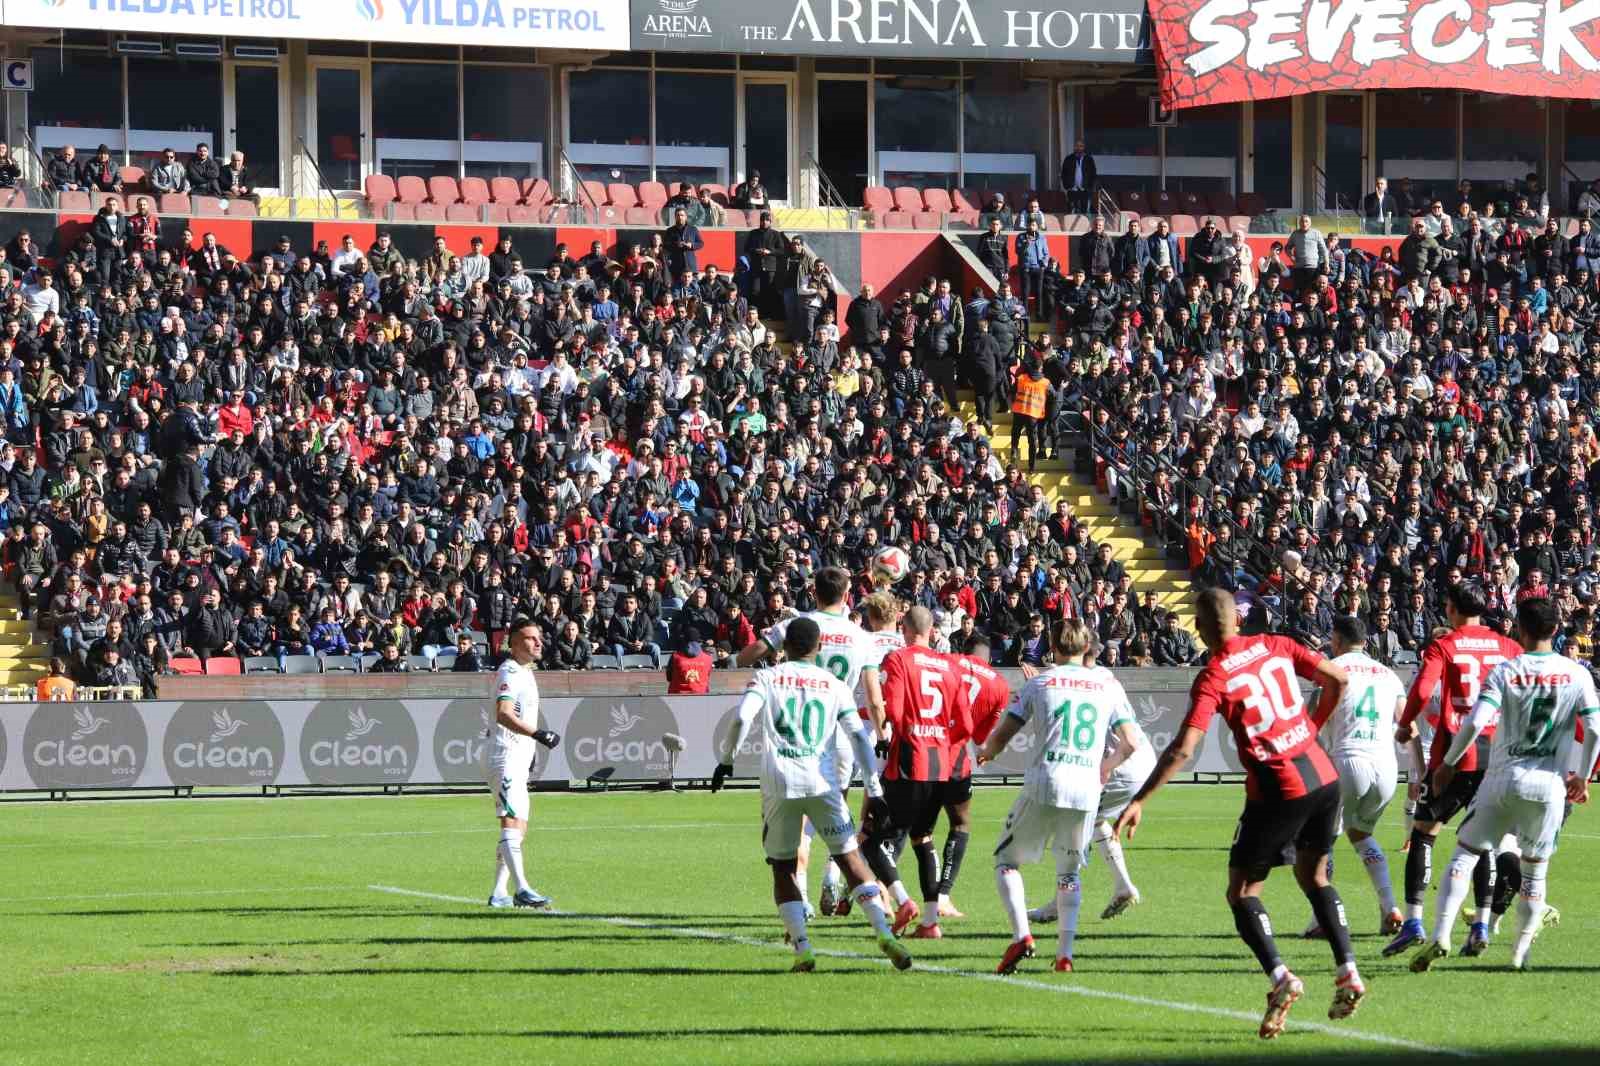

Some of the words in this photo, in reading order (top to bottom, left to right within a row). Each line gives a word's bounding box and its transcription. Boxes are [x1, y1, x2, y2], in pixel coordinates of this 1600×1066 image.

[512, 7, 606, 31] PETROL
[643, 15, 712, 33] ARENA
[740, 26, 777, 40] THE
[781, 0, 988, 46] ARENA
[8, 62, 26, 86] C
[919, 670, 943, 719] 5
[1226, 656, 1304, 738] 30
[1355, 686, 1379, 722] 4
[774, 697, 826, 748] 40
[1054, 700, 1098, 750] 18
[33, 740, 136, 766] Clean
[174, 742, 273, 768] Clean
[310, 740, 408, 767] Clean
[574, 737, 669, 762] Clean
